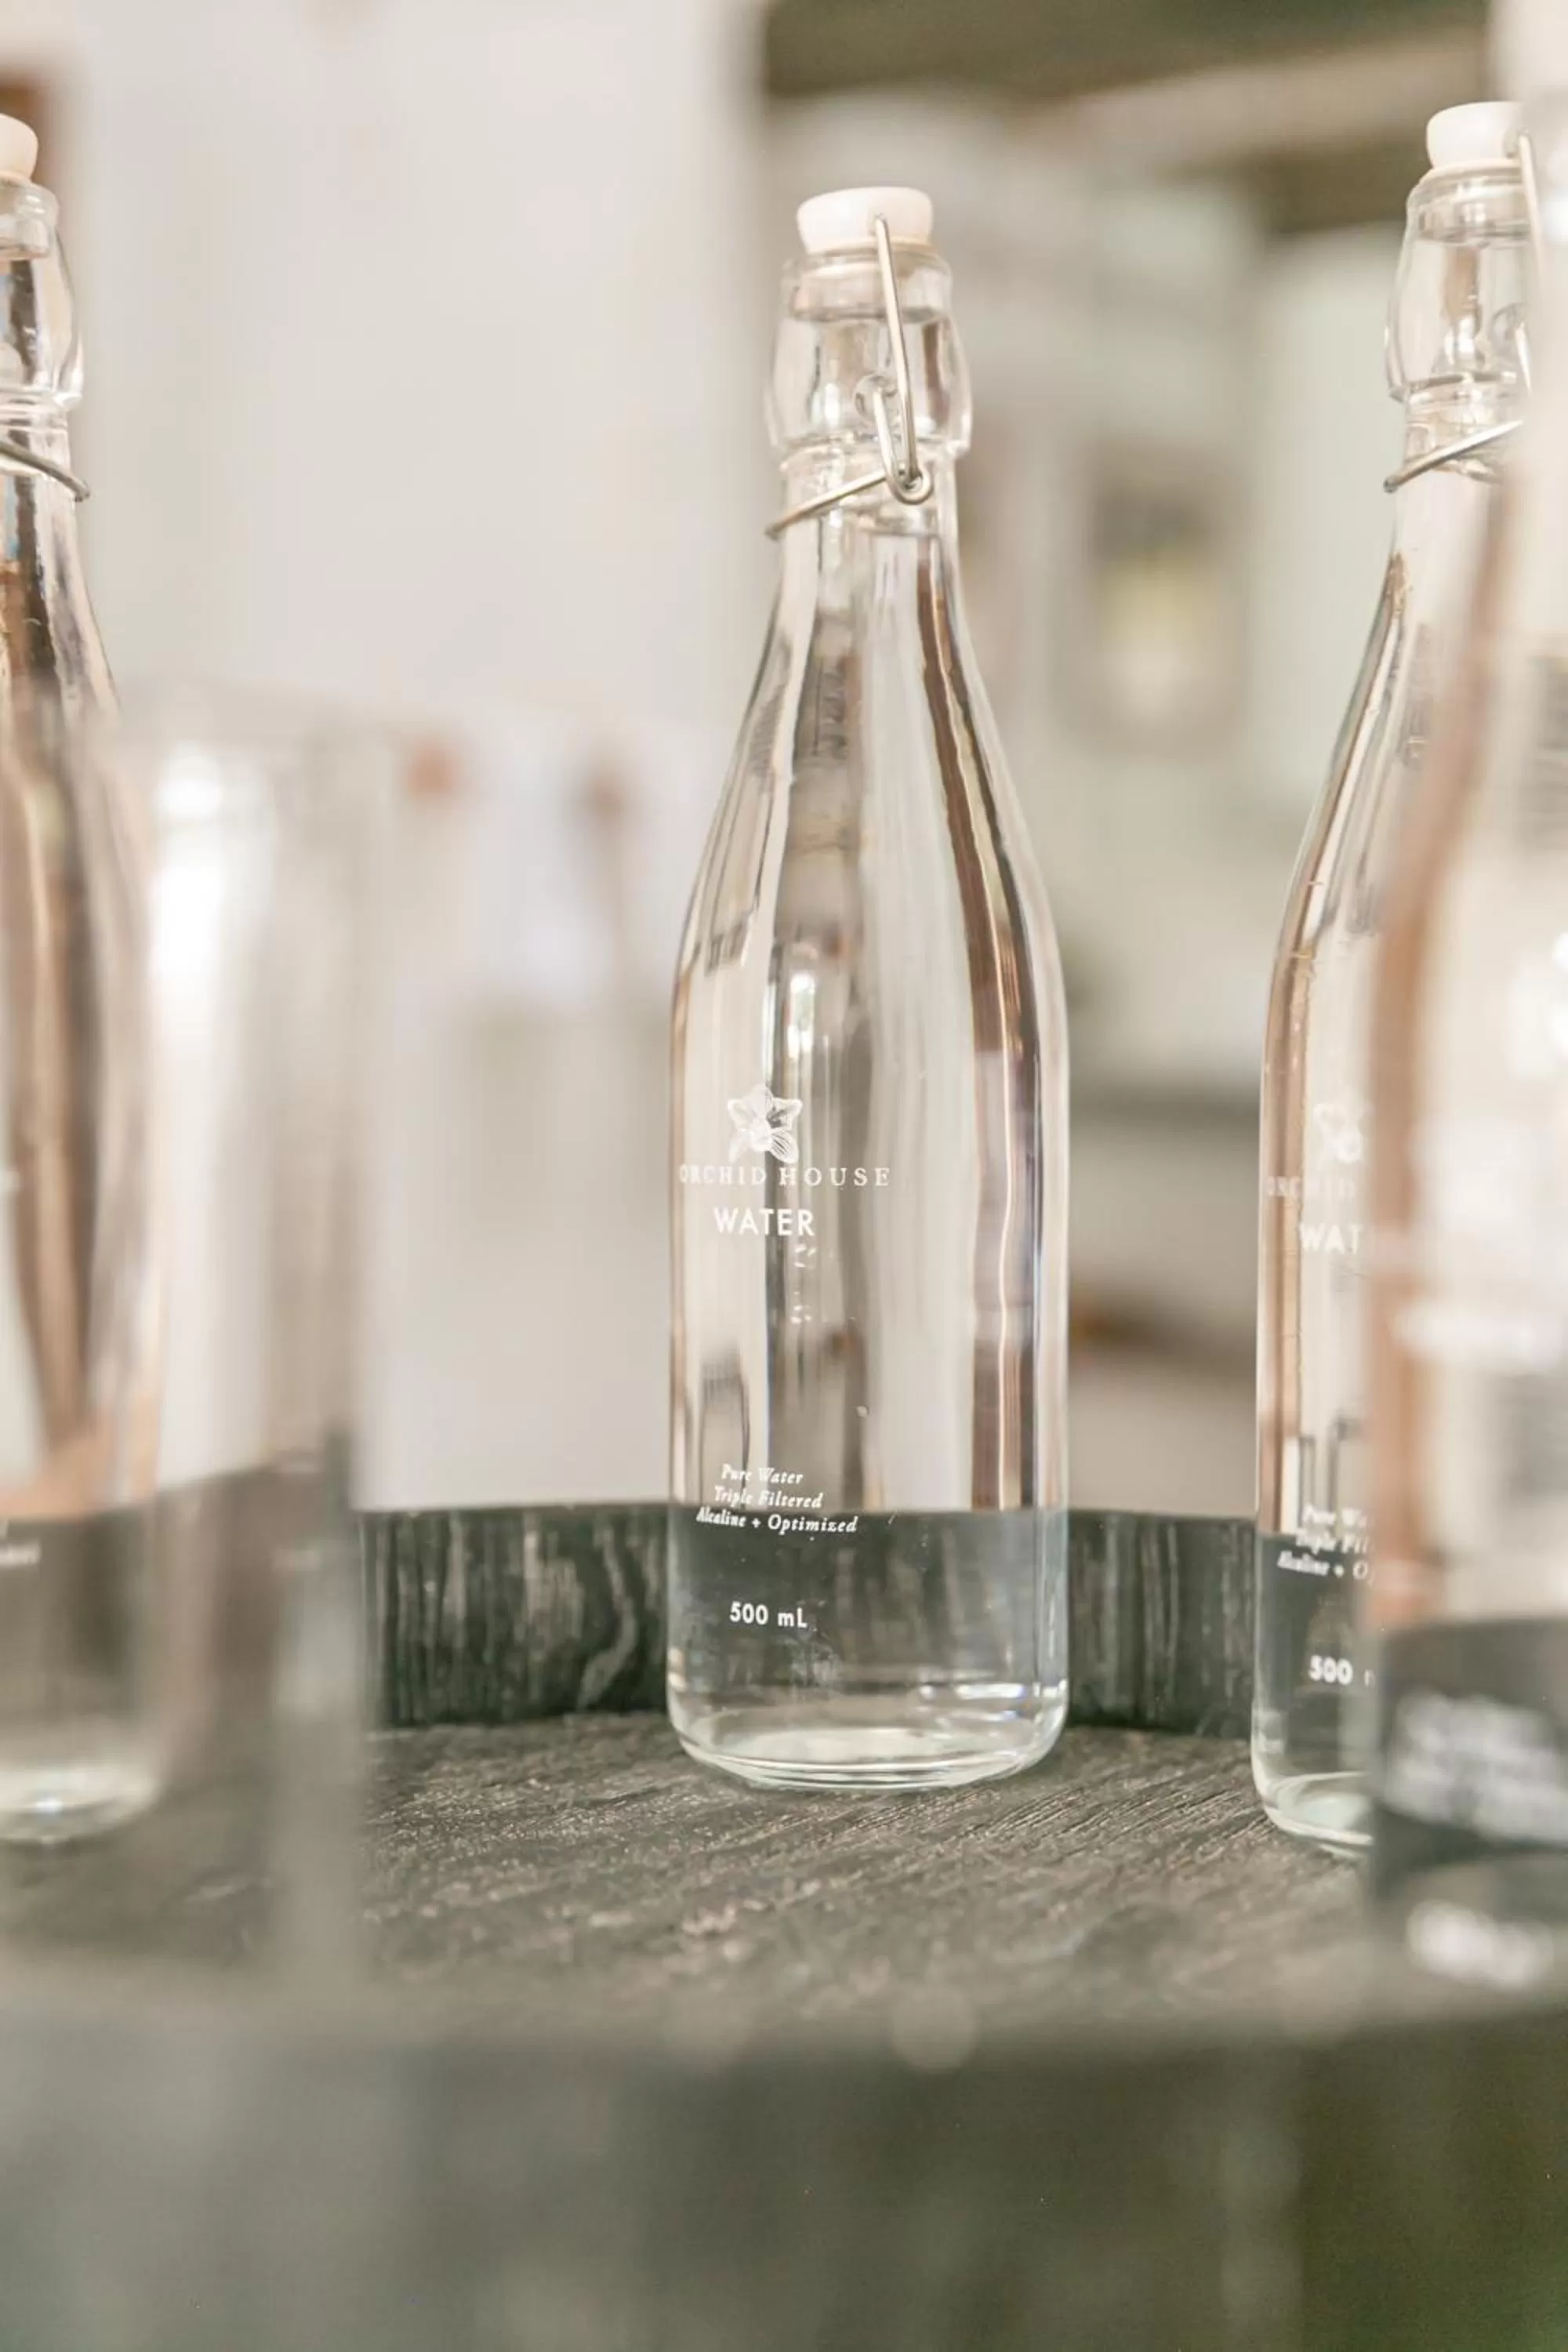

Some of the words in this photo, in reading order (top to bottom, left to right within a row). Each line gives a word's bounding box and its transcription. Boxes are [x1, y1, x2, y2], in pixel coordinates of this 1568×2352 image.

[679, 1163, 767, 1187] ORCHID
[779, 1167, 891, 1187] HOUSE
[713, 1206, 816, 1236] WATER
[1298, 1222, 1365, 1255] WAT
[720, 1463, 751, 1482] Pure
[758, 1467, 804, 1484] Water
[714, 1486, 753, 1508] Triple
[758, 1490, 824, 1508] Filtered
[696, 1506, 746, 1527] Alkaline
[768, 1514, 859, 1535] Optimized
[729, 1601, 769, 1625] 500
[777, 1607, 808, 1628] mL
[1308, 1654, 1354, 1686] 500
